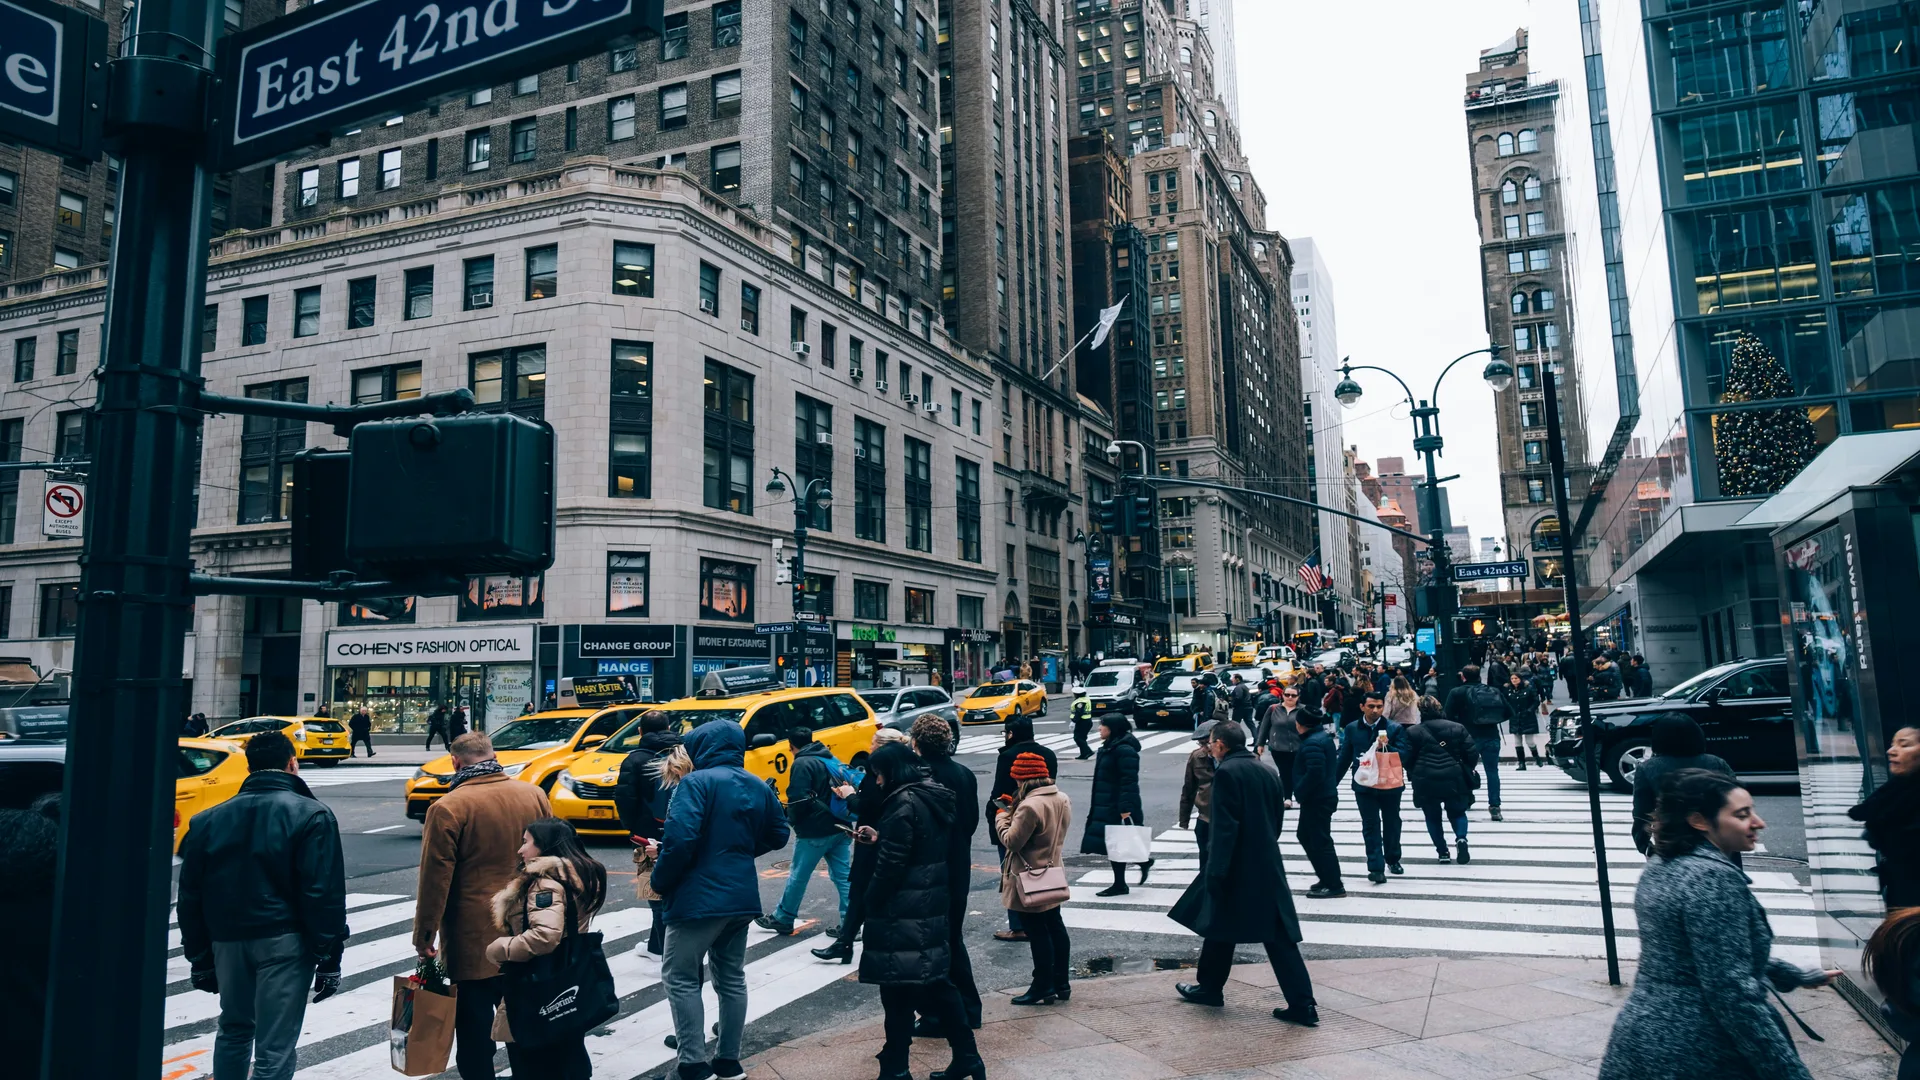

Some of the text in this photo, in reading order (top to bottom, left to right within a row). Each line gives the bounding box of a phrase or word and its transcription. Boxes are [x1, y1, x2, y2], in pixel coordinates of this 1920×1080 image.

[252, 0, 520, 118] East 42nd
[1458, 565, 1523, 576] East 42nd St
[1844, 533, 1868, 670] Newsstand
[337, 638, 520, 656] COHEN'S FASHION OPTICAL
[584, 642, 672, 650] CHANGE GROUP
[698, 636, 767, 648] MONEY EXCHANGE
[598, 663, 649, 672] HANGE
[576, 683, 622, 694] HARRY POTTER
[539, 996, 574, 1016] 4imprint
